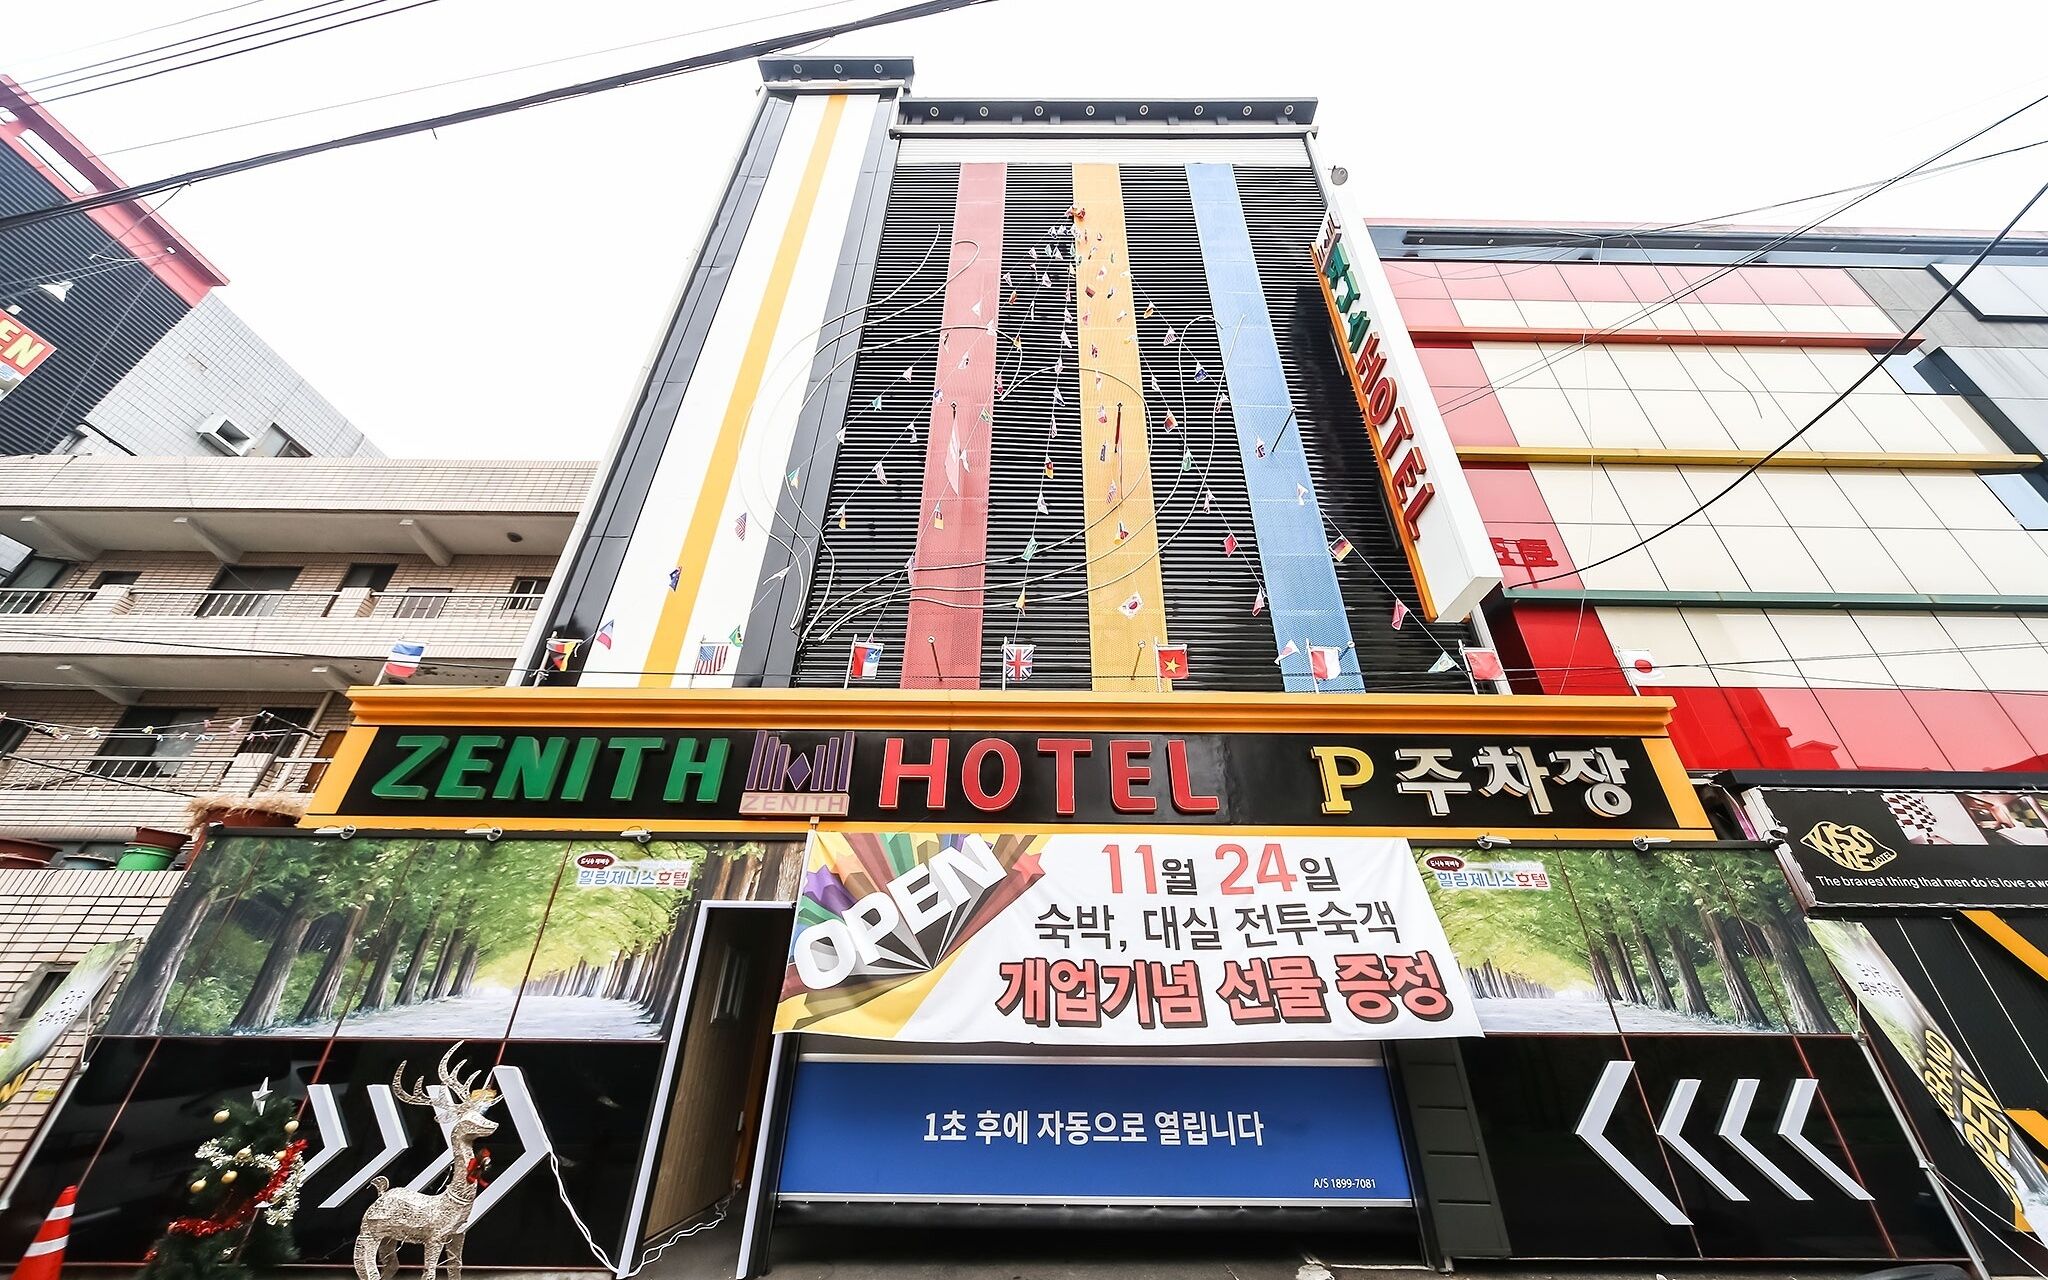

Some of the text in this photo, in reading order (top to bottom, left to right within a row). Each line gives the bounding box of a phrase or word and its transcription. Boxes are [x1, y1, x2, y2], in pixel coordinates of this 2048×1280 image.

[1356, 331, 1435, 542] HOTEL
[371, 734, 731, 804] ZENITH
[878, 737, 1220, 814] HOTEL
[1310, 745, 1635, 817] P 주차장
[741, 794, 847, 814] ZENITH
[1811, 822, 1875, 856] KISS
[1102, 842, 1340, 896] 11월 24일
[1832, 850, 1872, 869] ME
[1871, 851, 1894, 868] MOTEL
[579, 870, 688, 887] 힐링제니스호텔
[1437, 872, 1549, 888] 힐링제니스호텔
[1816, 876, 1841, 887] The
[1842, 876, 1886, 888] bravest
[1886, 876, 1920, 889] thing
[1919, 877, 1944, 888] that
[1944, 879, 1972, 888] men
[1997, 877, 2026, 888] love
[795, 833, 1007, 989] OPEN
[1034, 900, 1404, 952] 숙박, 대실 전투숙객
[996, 950, 1455, 1028] 개업기념 선물 증정
[923, 1110, 1265, 1147] 1초 후에 자동으로 열립니다
[1313, 1177, 1376, 1189] A/S 1899-7081
